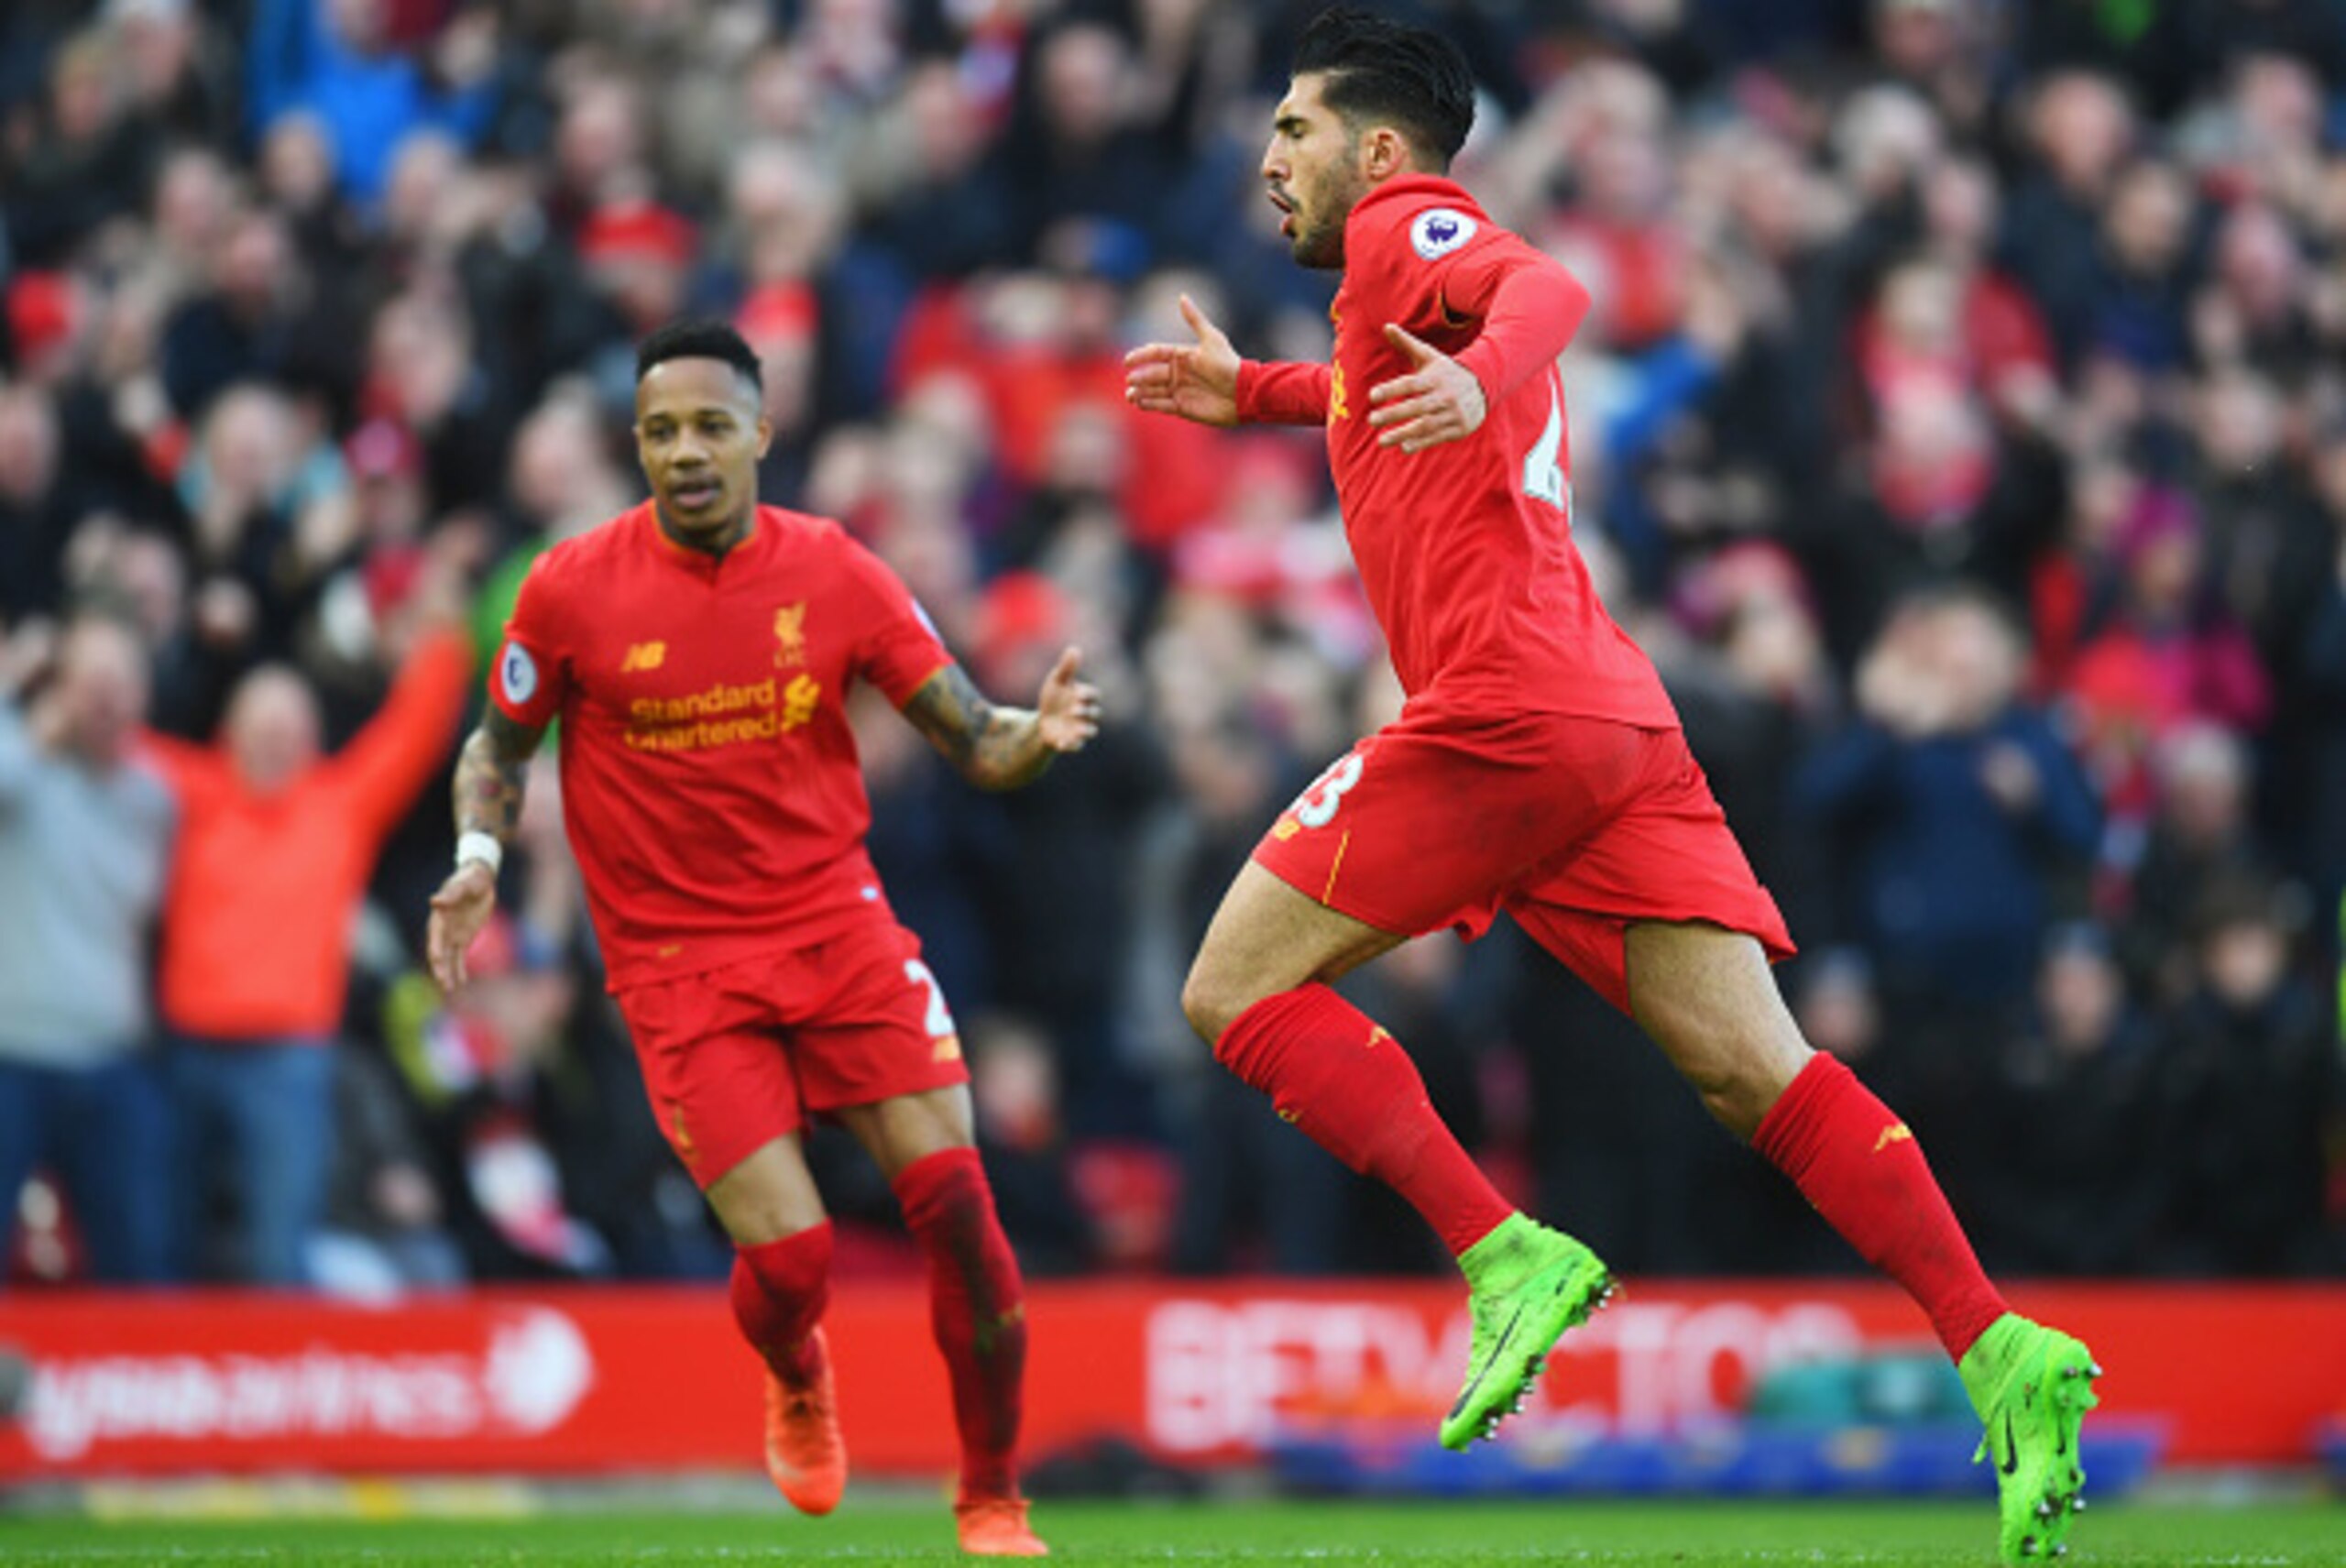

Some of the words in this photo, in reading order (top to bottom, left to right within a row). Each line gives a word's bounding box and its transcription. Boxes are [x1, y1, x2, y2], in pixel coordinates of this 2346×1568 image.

[629, 676, 775, 724] Standard
[624, 709, 776, 751] Chartered
[903, 957, 956, 1036] 2
